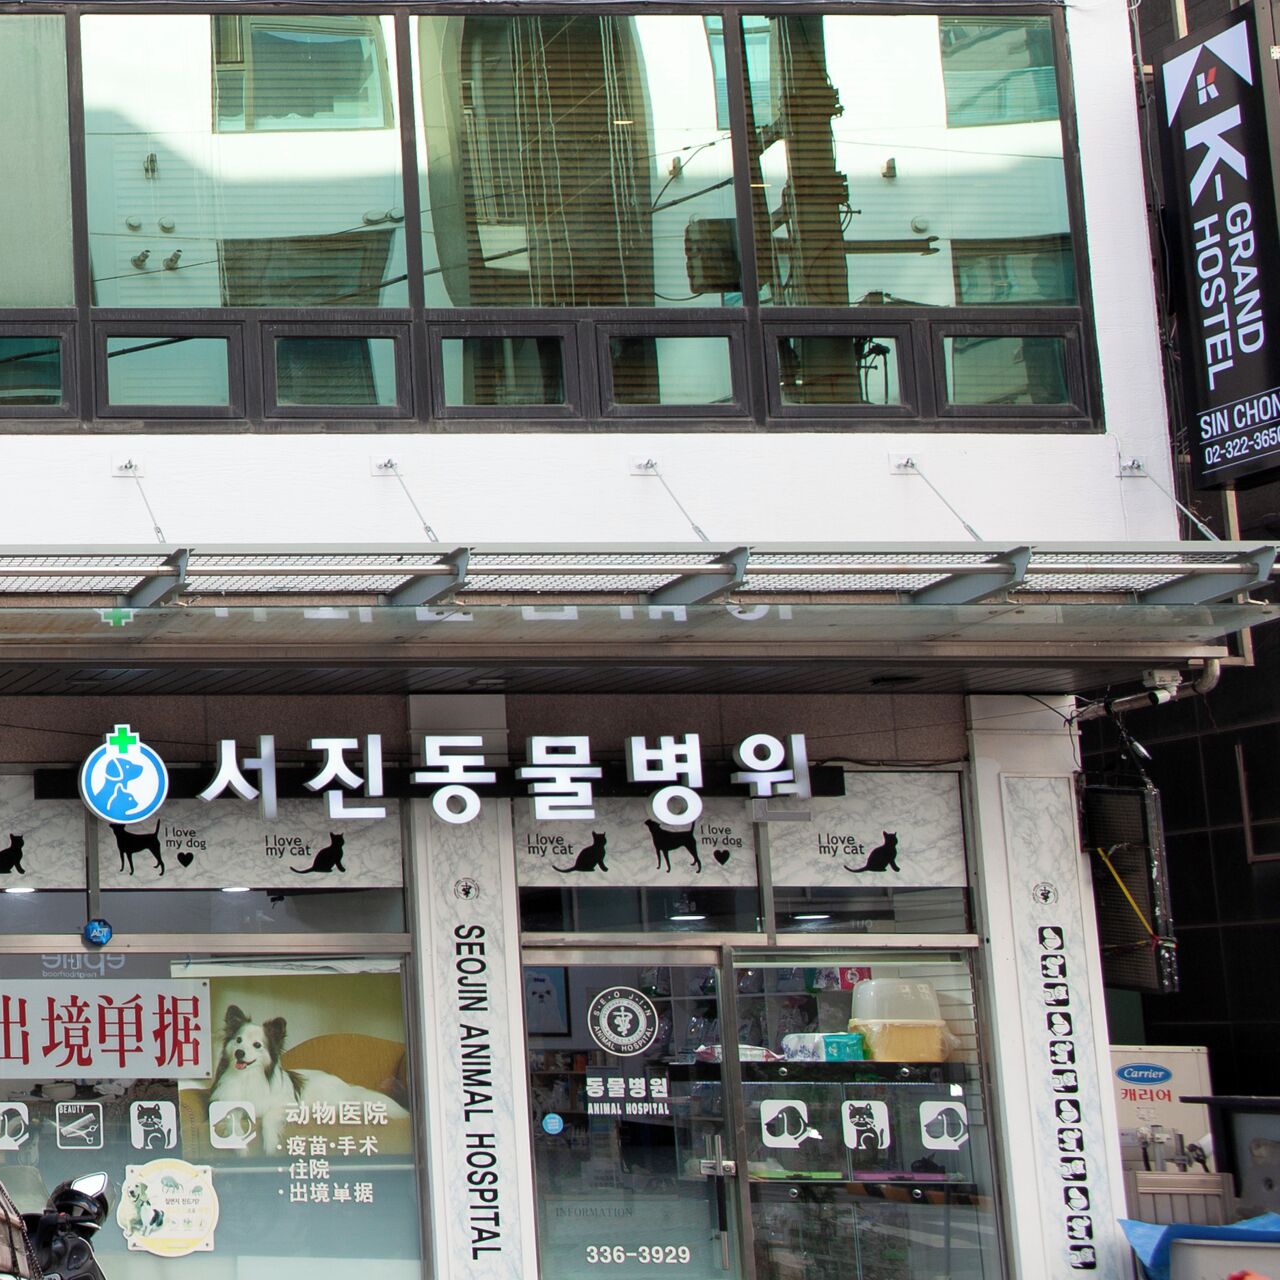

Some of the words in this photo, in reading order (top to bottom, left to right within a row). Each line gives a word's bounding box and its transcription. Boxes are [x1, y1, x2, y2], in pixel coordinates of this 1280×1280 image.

[1226, 201, 1265, 354] GRAND
[1193, 213, 1234, 391] HOSTEL
[1200, 409, 1229, 440] SIN
[196, 733, 812, 826] 서진동물병원
[174, 827, 197, 839] love
[709, 825, 732, 837] love
[165, 839, 185, 850] my
[187, 837, 206, 851] dog
[274, 835, 302, 847] love
[536, 834, 564, 846] love
[701, 837, 720, 848] my
[723, 835, 743, 849] dog
[827, 834, 855, 846] love
[265, 847, 287, 859] my
[290, 846, 312, 857] cat
[528, 846, 549, 857] my
[552, 845, 574, 856] cat
[819, 846, 840, 857] my
[843, 845, 865, 856] cat
[90, 927, 109, 937] ADT
[454, 924, 488, 1012] SEOJIN
[593, 1024, 616, 1051] ANIMAL
[621, 1026, 654, 1052] HOSPITAL
[459, 1023, 495, 1122] ANIMAL
[1123, 1067, 1166, 1080] Carrier
[585, 1077, 669, 1098] 동물병원
[1120, 1087, 1173, 1103] 캐리어
[58, 1104, 86, 1114] BEAUTY
[284, 1100, 389, 1126] 动物医院
[587, 1102, 622, 1115] ANIMAL
[625, 1102, 670, 1115] HOSPITAL
[289, 1159, 330, 1180] 住院
[289, 1182, 374, 1204] 出境单据
[465, 1133, 502, 1261] HOSPITAL
[555, 1207, 633, 1217] INFORMATION
[585, 1245, 691, 1264] 336-3929
